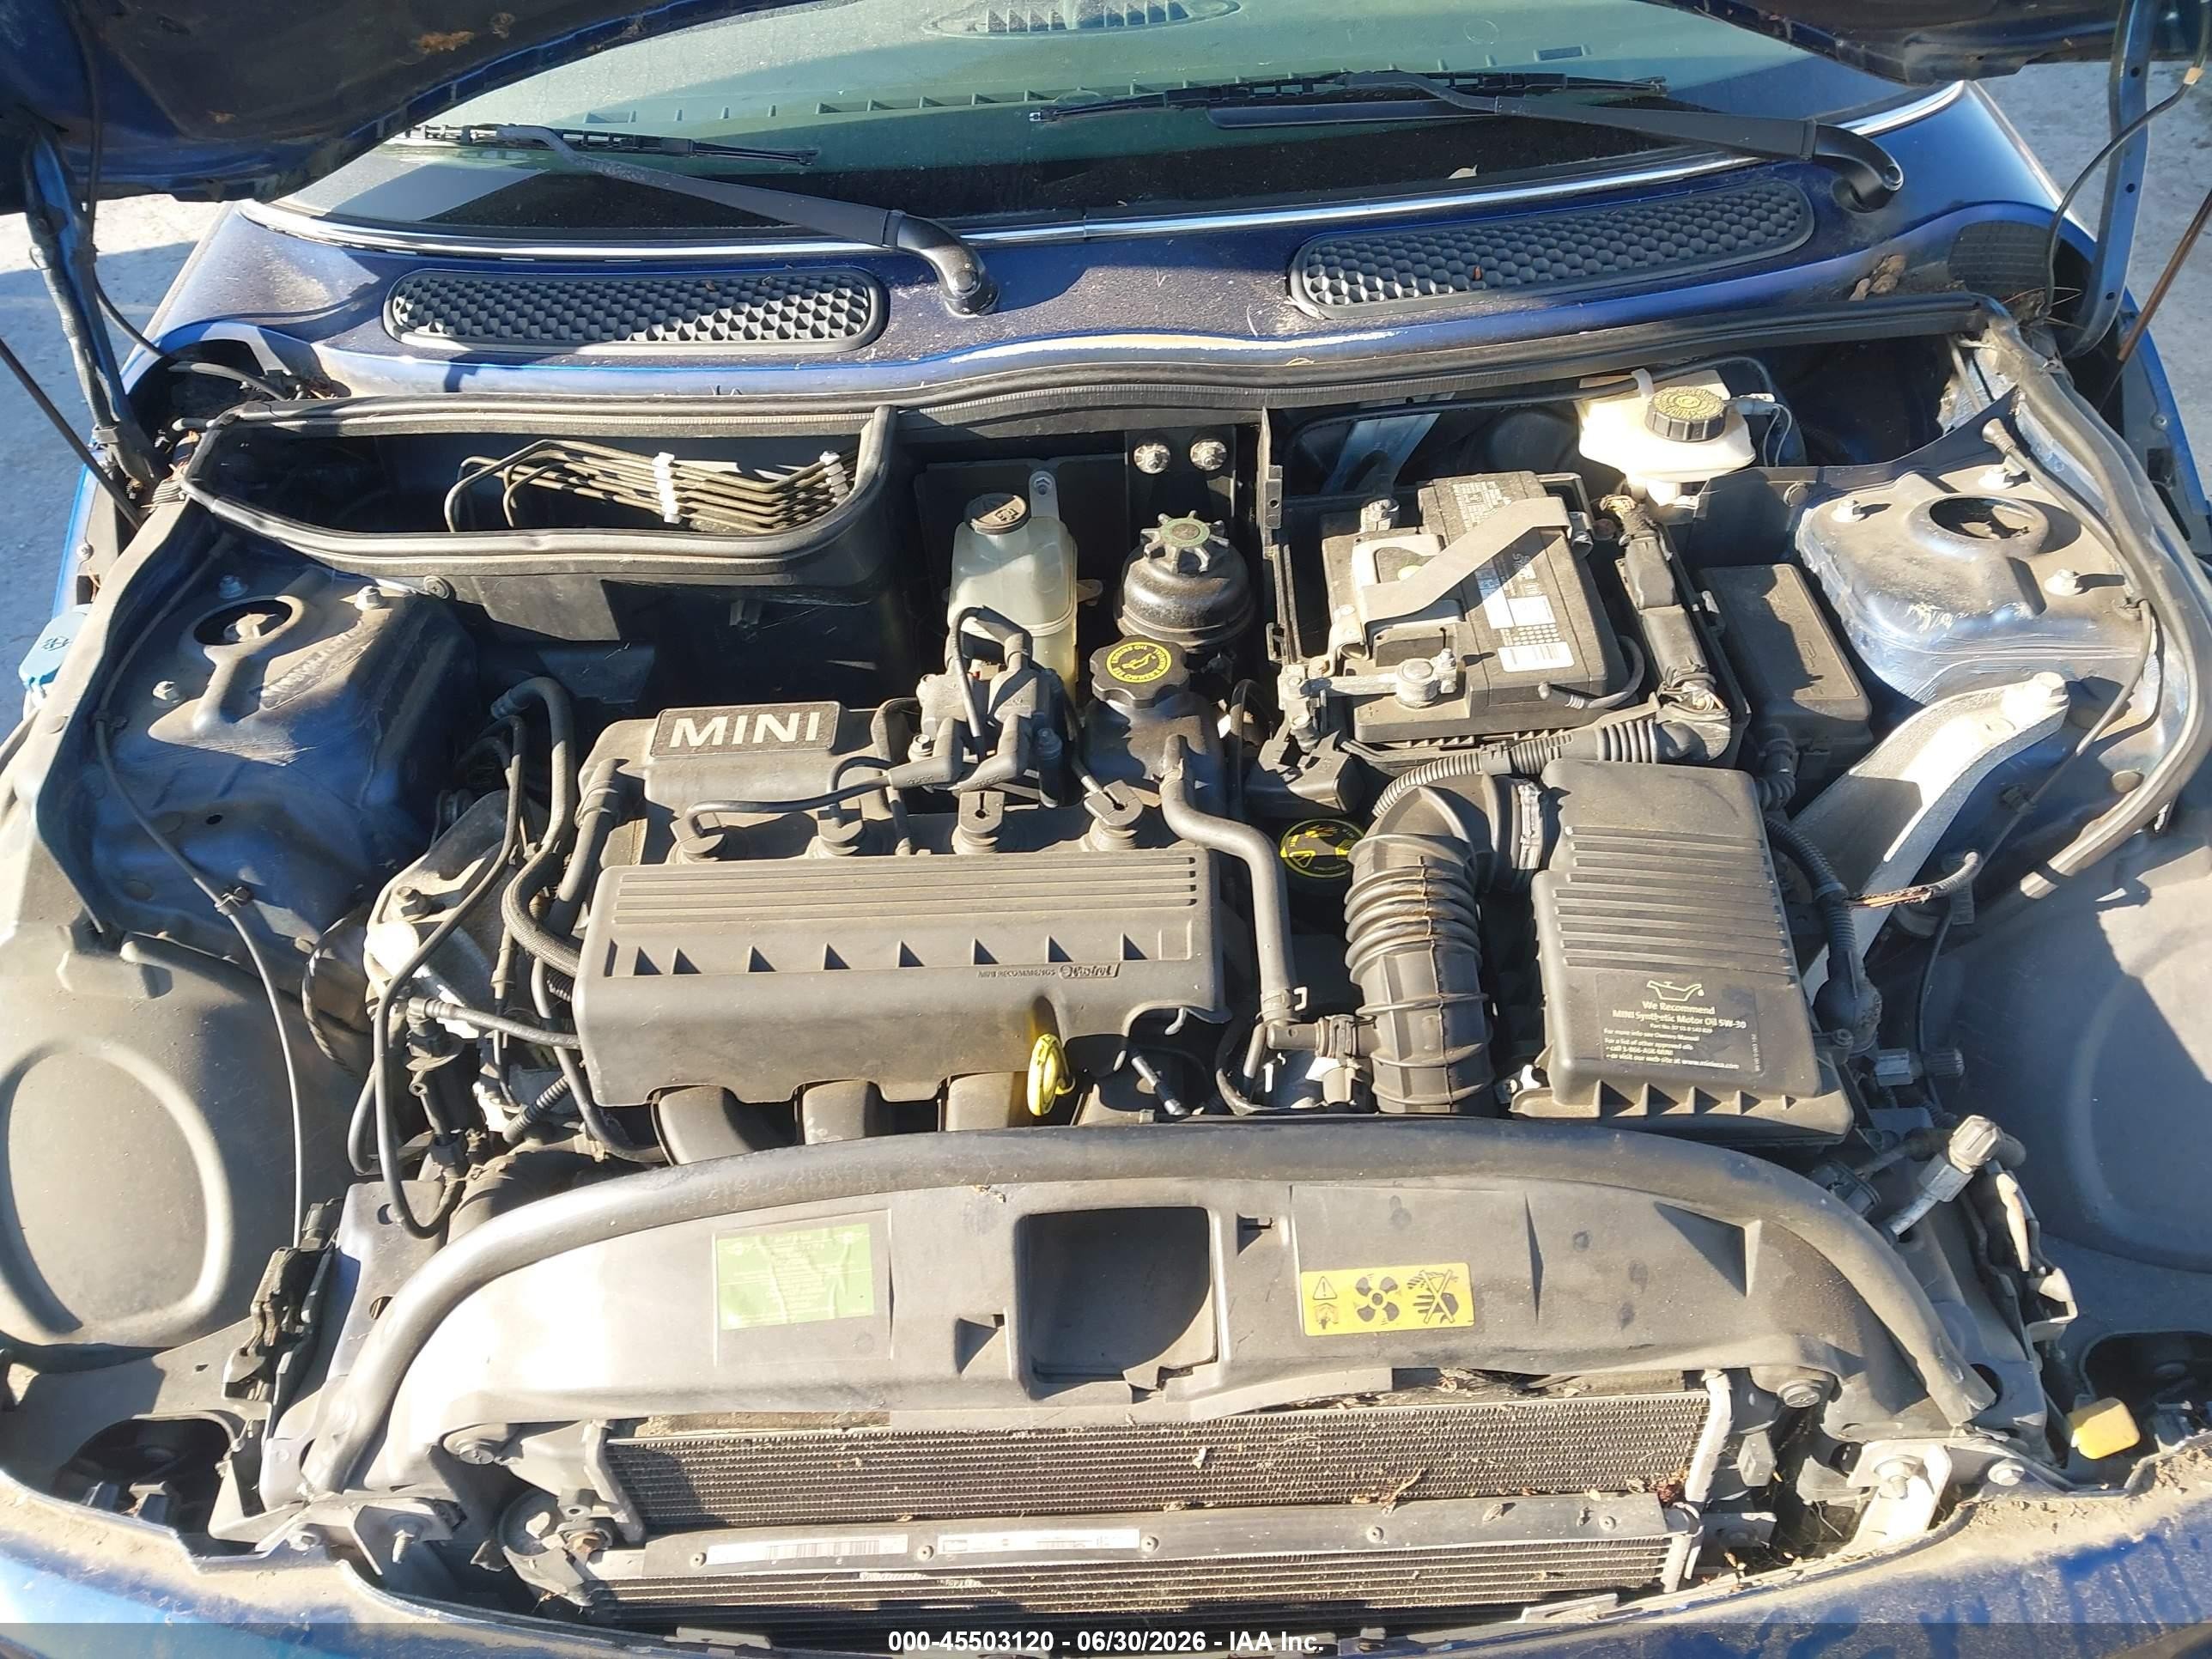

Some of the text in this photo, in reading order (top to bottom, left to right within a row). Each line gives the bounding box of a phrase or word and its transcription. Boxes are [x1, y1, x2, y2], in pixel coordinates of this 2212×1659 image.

[669, 712, 820, 748] MINI
[1642, 1000, 1716, 1015] We Recommend
[1613, 1010, 1635, 1019] MINI
[1635, 1011, 1675, 1023] Synthetic
[1676, 1015, 1704, 1024] Motor
[1718, 1019, 1747, 1029] 5W-30
